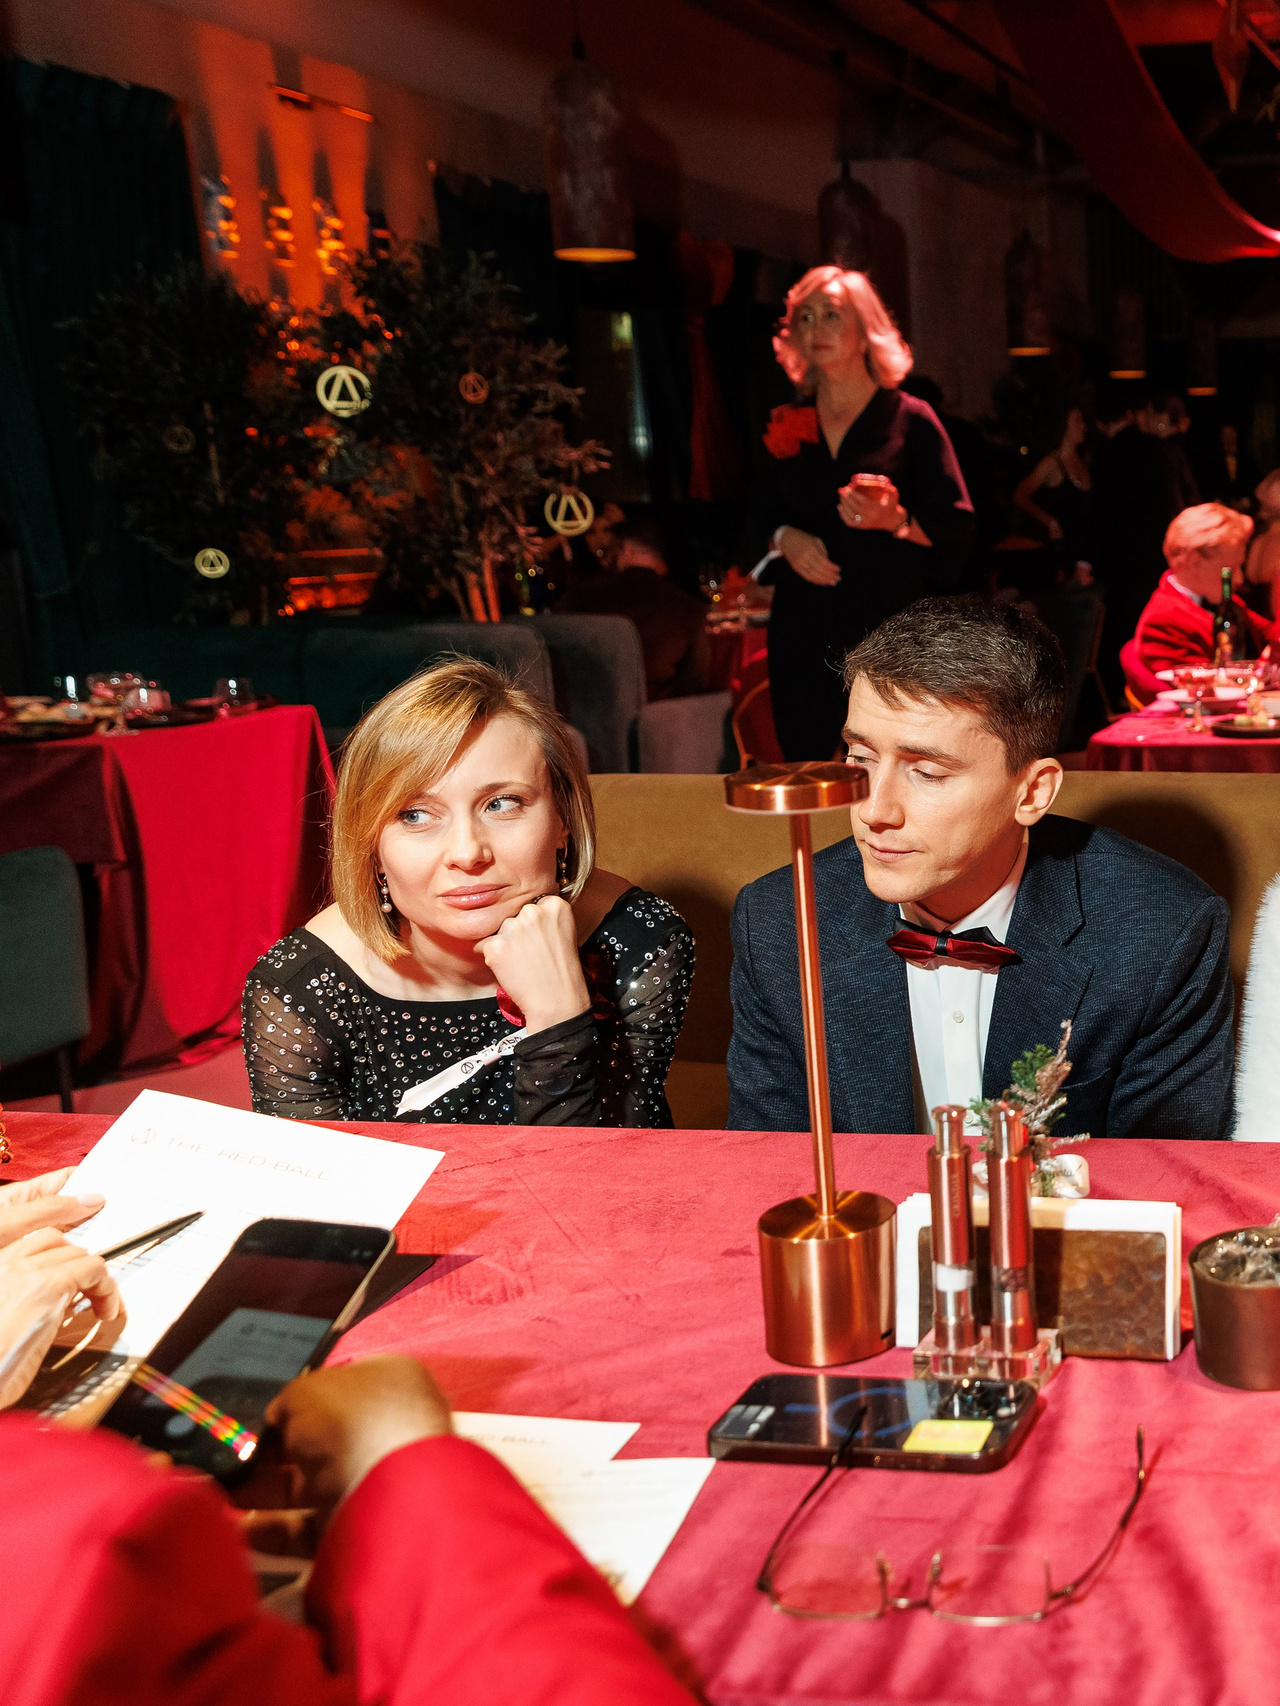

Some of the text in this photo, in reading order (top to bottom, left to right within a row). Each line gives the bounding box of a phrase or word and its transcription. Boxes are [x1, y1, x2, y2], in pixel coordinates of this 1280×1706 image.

[168, 1136, 329, 1181] THE RED BALL
